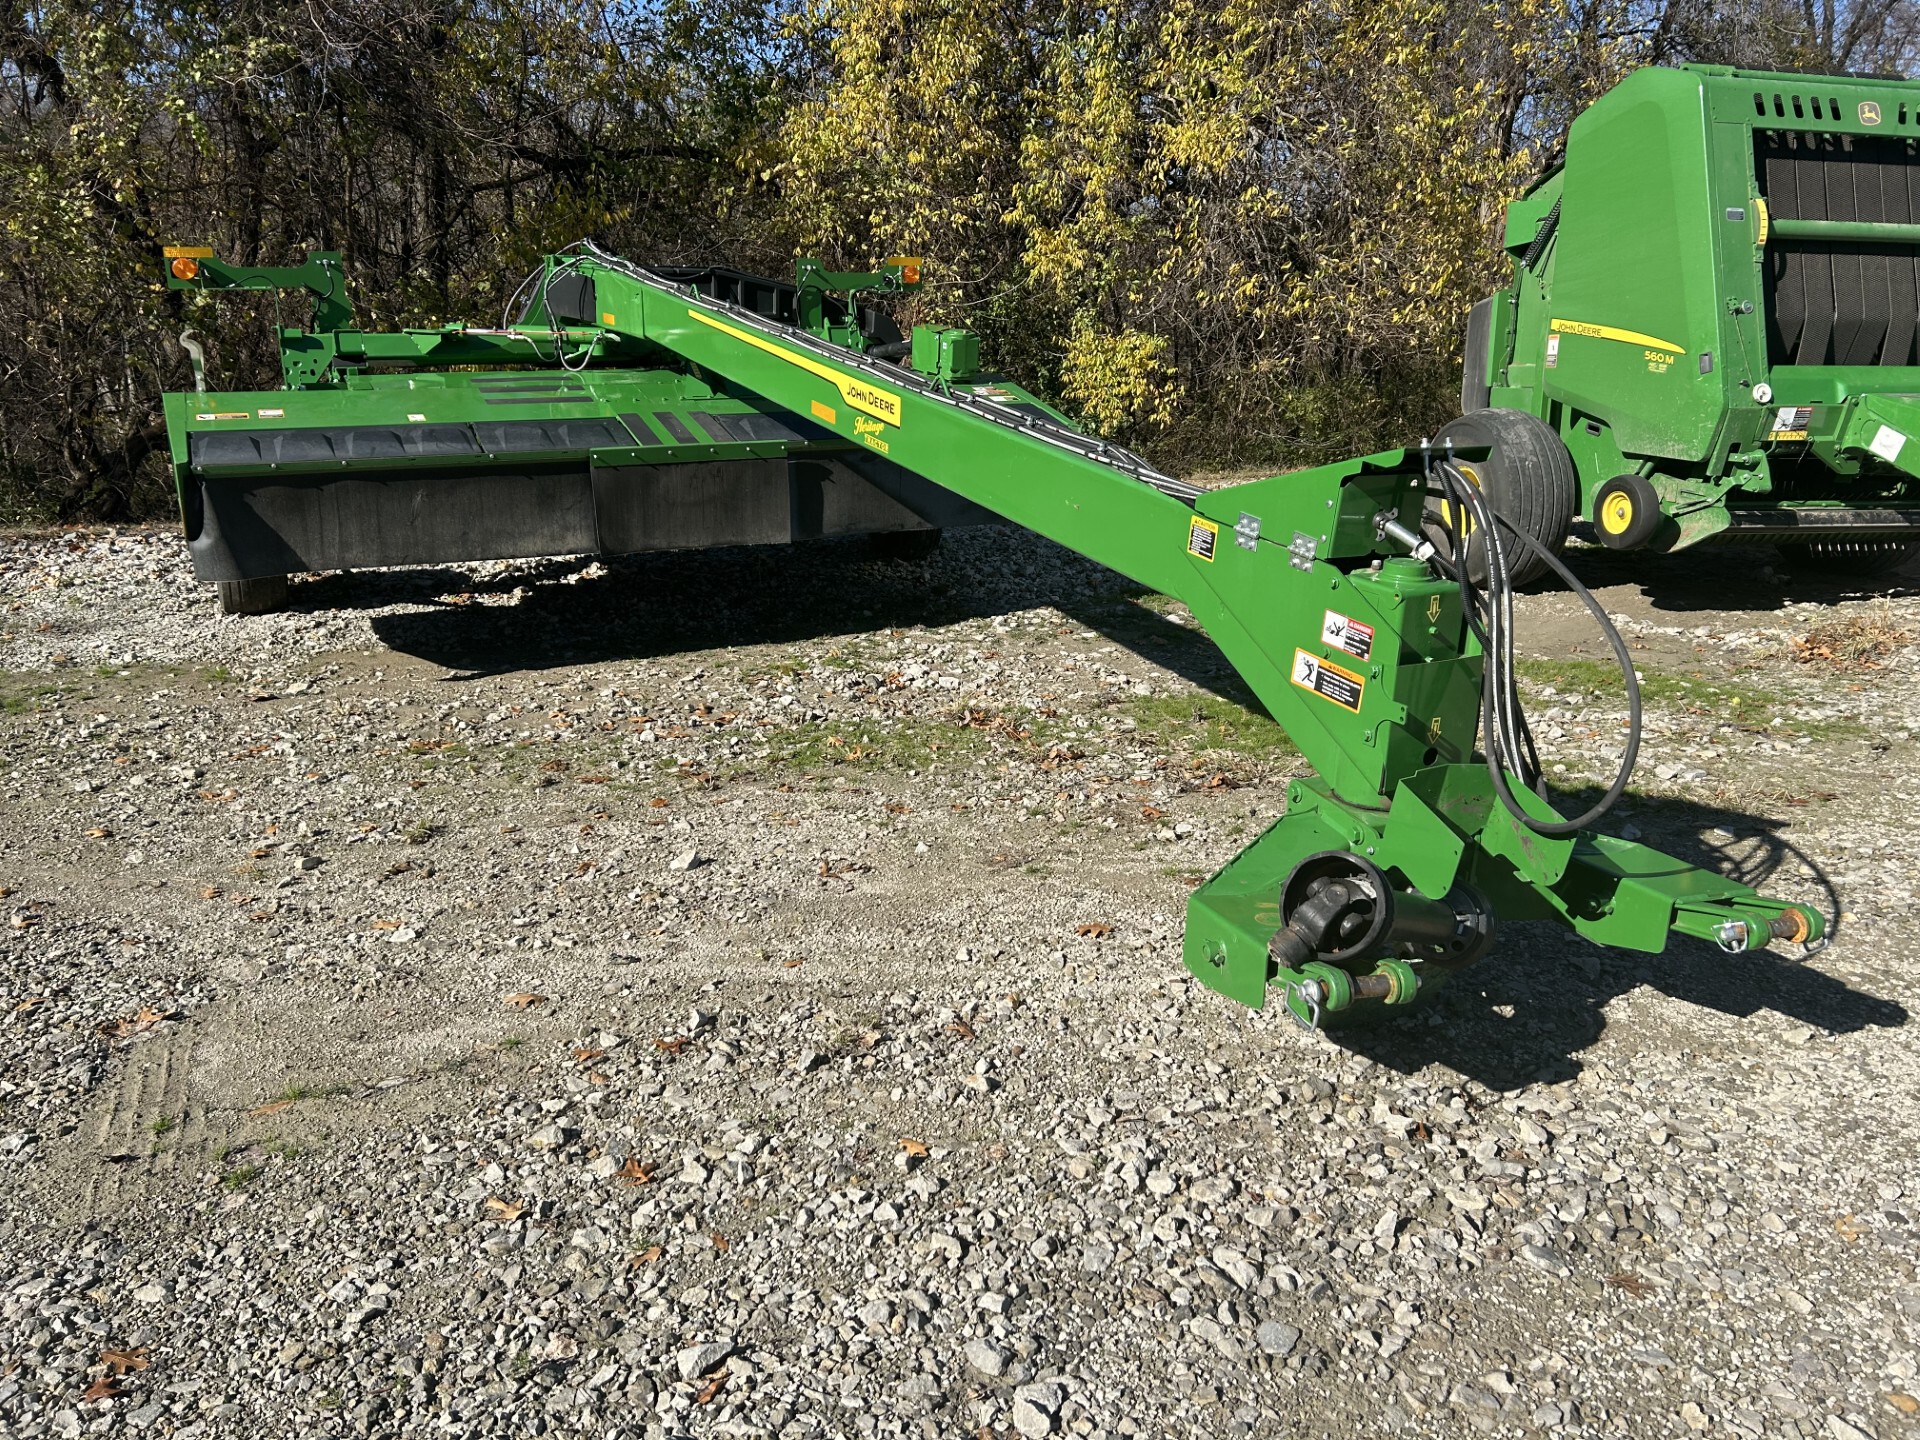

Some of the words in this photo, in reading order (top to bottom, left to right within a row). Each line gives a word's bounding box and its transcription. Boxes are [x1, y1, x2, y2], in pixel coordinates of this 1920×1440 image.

[1556, 321, 1576, 333] JOHN
[1577, 323, 1602, 337] DEERE
[846, 382, 867, 403] JOHN
[868, 391, 895, 415] DEERE
[853, 416, 885, 435] Heritage
